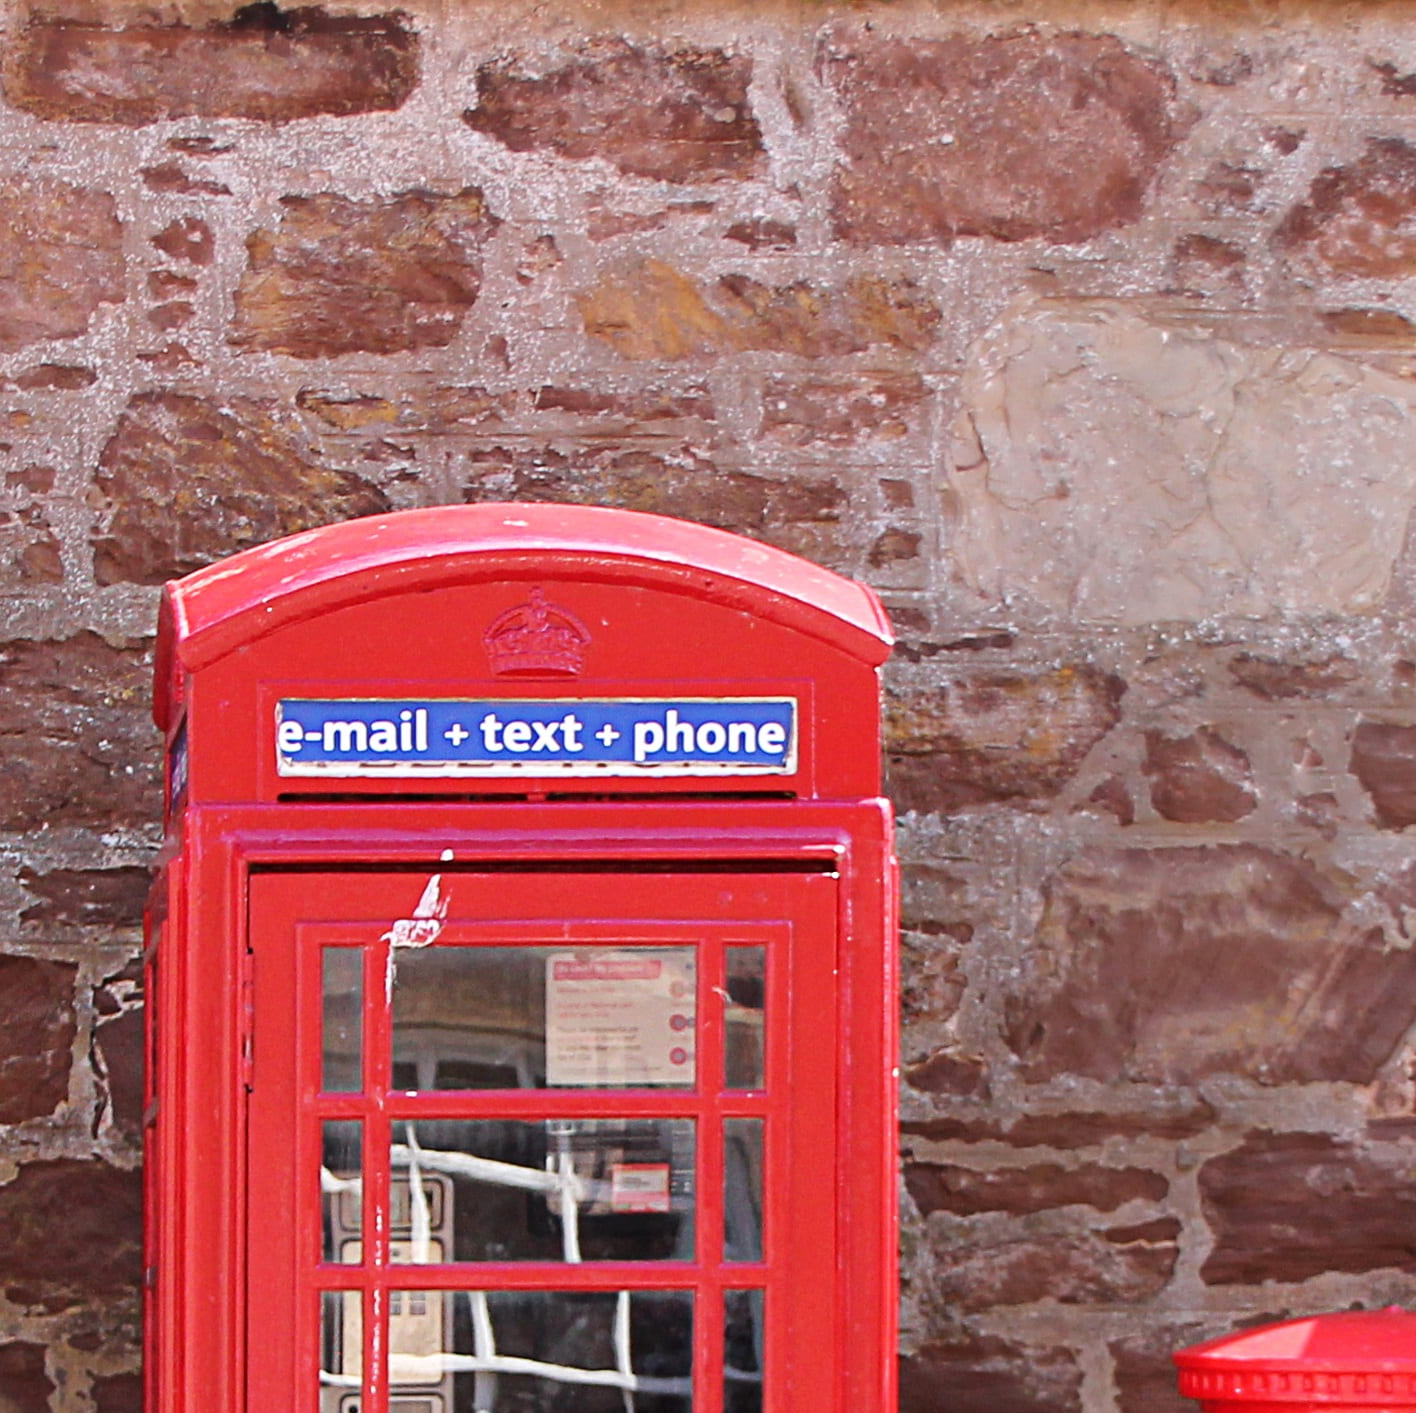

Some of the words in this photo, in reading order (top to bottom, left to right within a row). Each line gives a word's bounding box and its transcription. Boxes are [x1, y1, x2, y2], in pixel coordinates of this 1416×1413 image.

[279, 708, 428, 753] e-mail
[480, 711, 583, 753] text
[634, 709, 786, 761] phone
